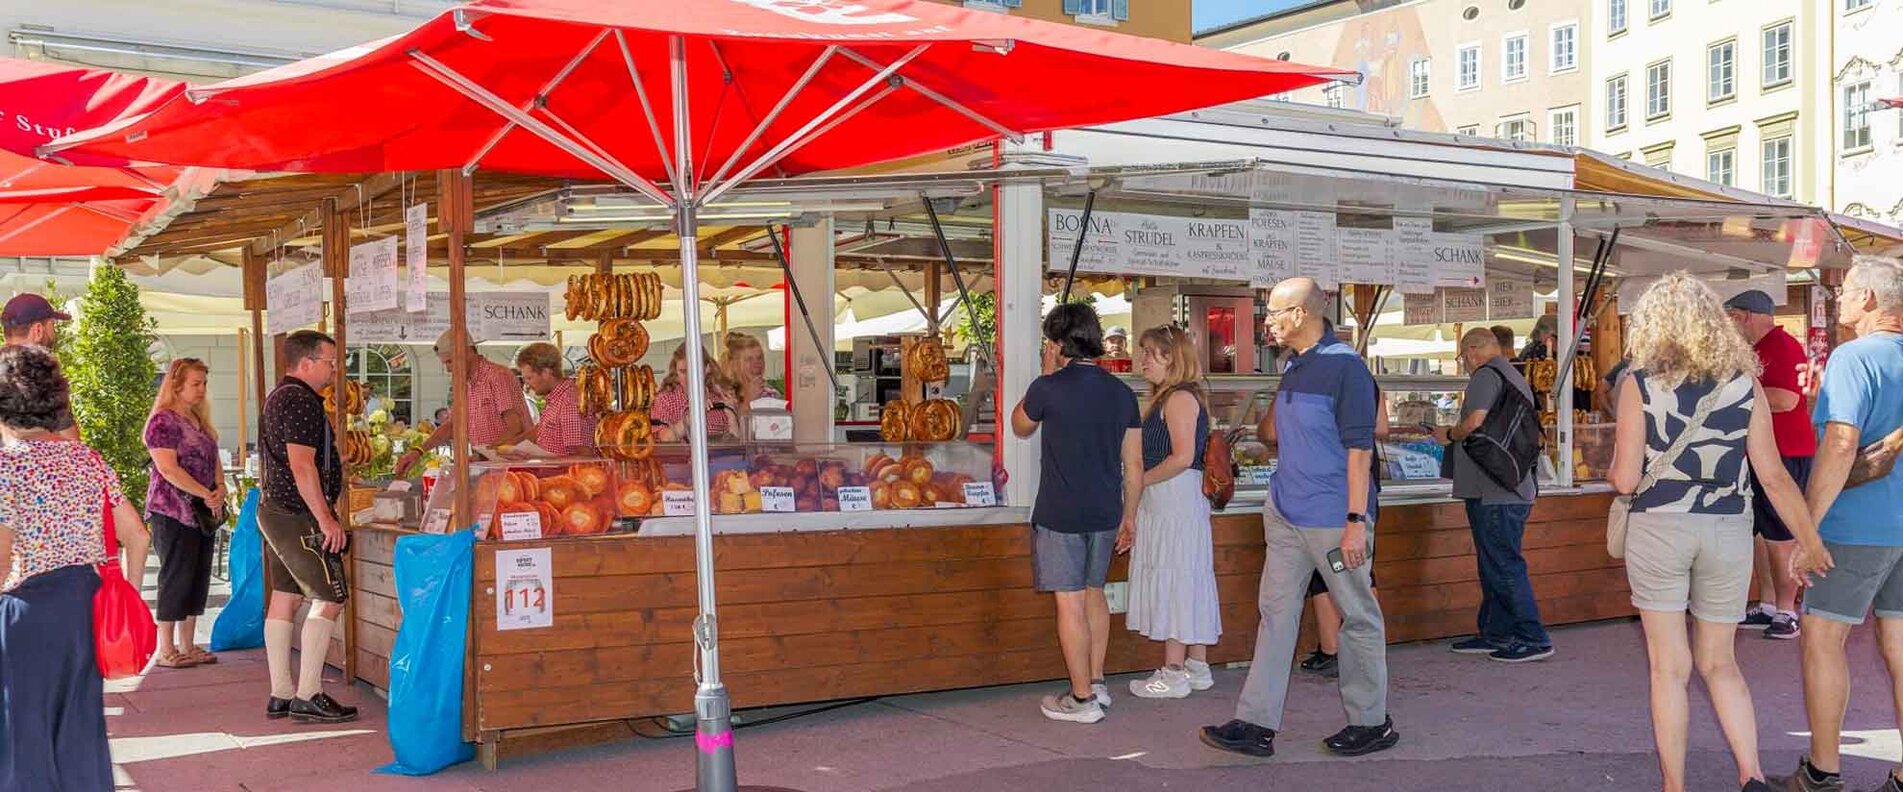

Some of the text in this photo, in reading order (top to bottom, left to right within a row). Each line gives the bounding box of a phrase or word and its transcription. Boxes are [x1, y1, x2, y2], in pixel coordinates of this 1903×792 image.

[1124, 230, 1177, 246] STRUDEL
[1188, 222, 1245, 240] KRAPFEN
[1253, 239, 1288, 251] KRAPFEN
[1434, 247, 1482, 264] SCHANK
[484, 305, 546, 320] SCHANK
[504, 587, 546, 609] 112
